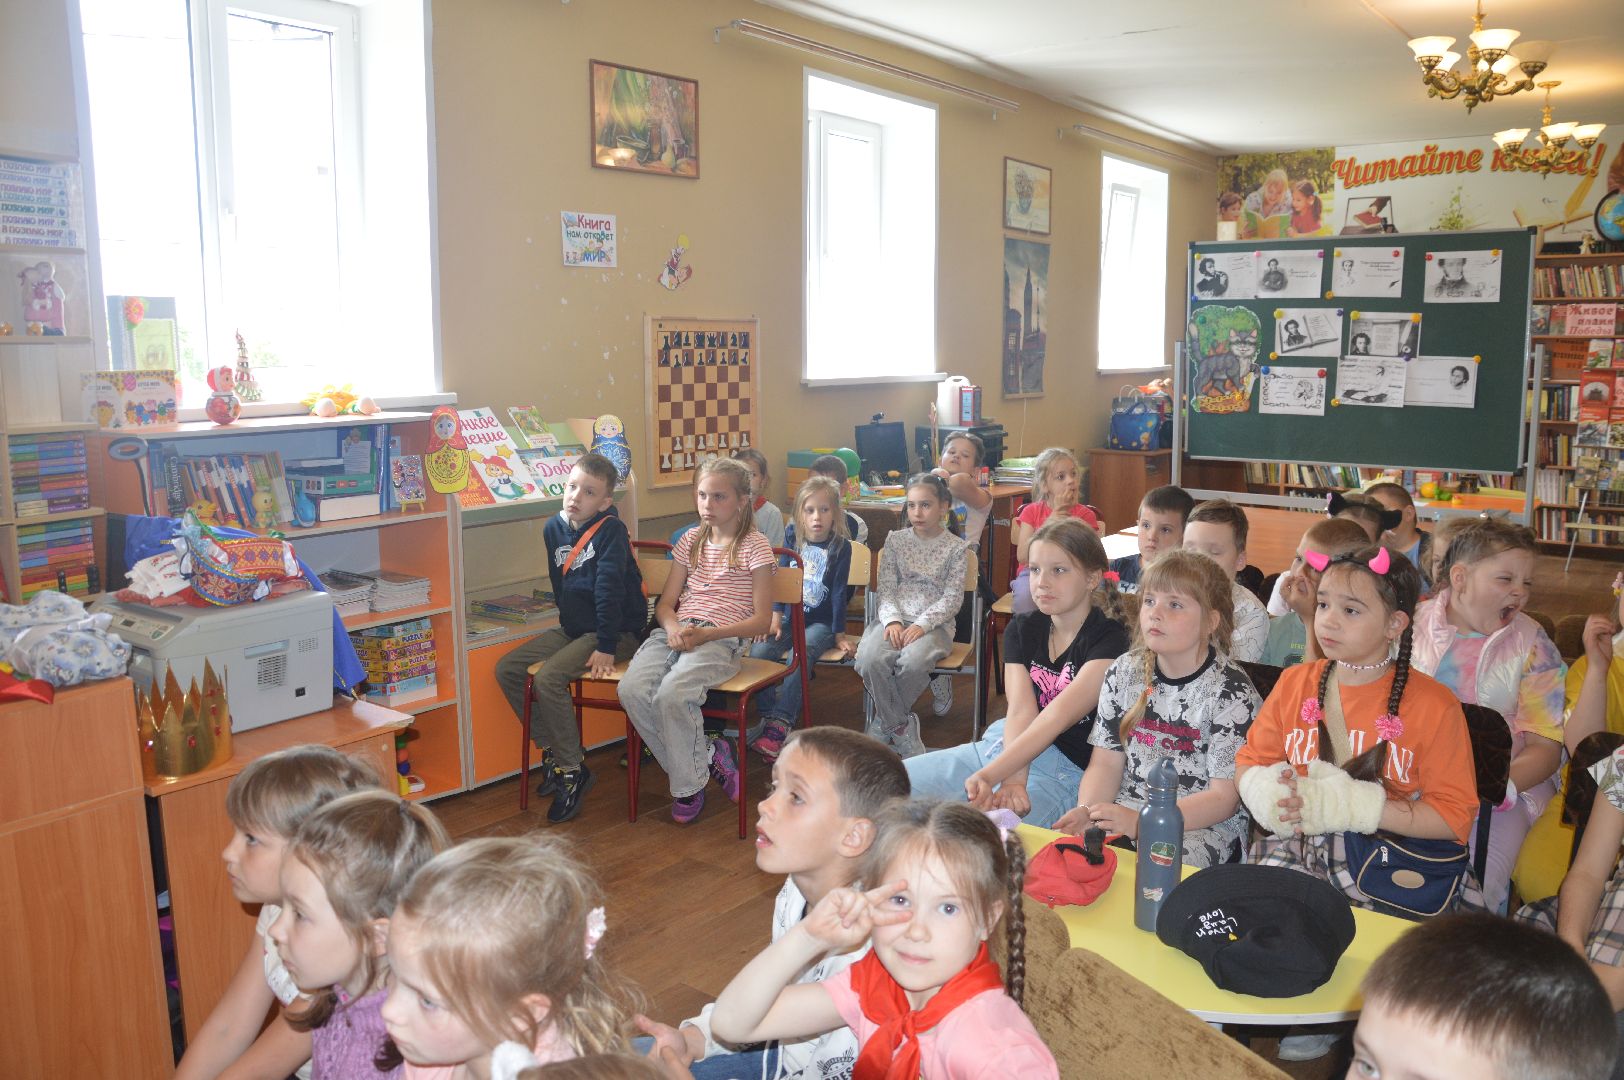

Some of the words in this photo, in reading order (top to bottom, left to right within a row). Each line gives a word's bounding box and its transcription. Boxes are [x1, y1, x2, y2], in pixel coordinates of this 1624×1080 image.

[1330, 144, 1483, 189] Читайте
[577, 214, 611, 231] Книга
[566, 230, 582, 239] нам
